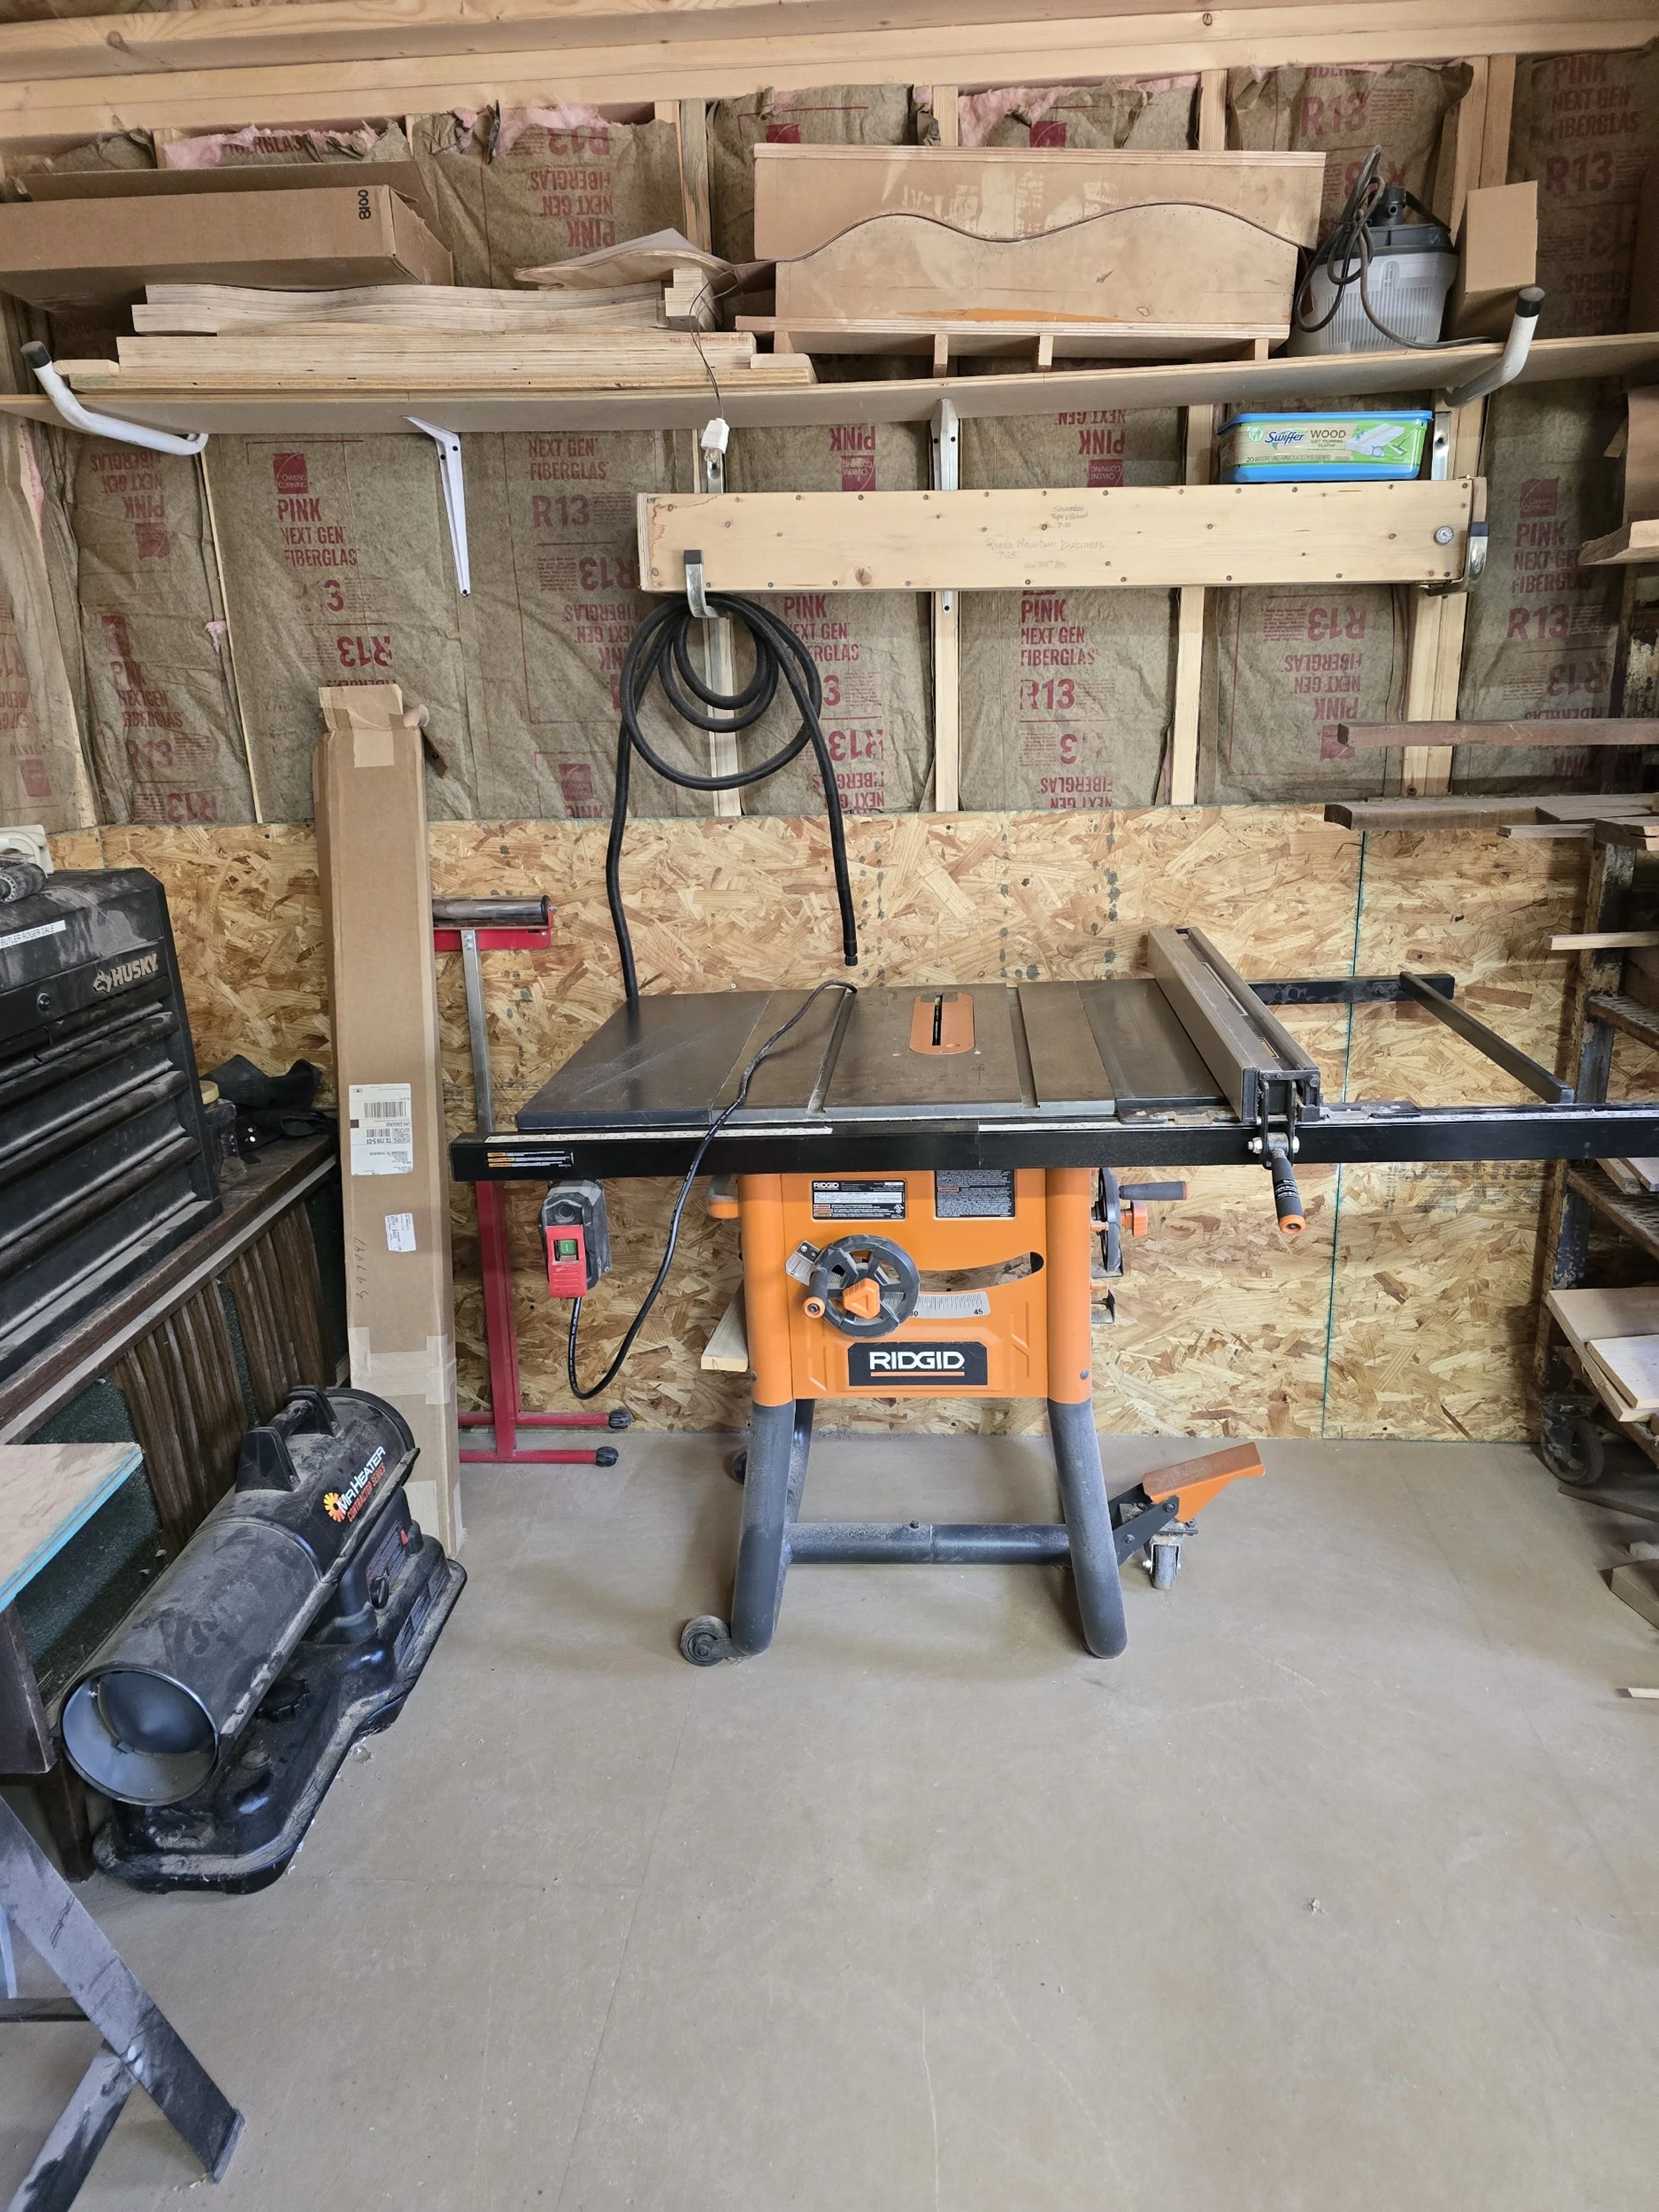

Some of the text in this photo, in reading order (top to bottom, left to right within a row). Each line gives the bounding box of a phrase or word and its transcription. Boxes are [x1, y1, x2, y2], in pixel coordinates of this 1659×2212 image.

[1300, 91, 1367, 137] R13
[530, 170, 611, 191] FIBERGLAS
[1545, 151, 1613, 192] R13
[542, 195, 613, 216] NEXT GEN
[566, 218, 616, 248] PINK
[1058, 409, 1126, 425] NEXT GEN
[830, 425, 875, 451] PINK
[1078, 429, 1125, 455] PINK
[1265, 431, 1305, 445] Swiffer
[1311, 429, 1346, 439] WOOD
[528, 439, 595, 458] NEXT GEN
[532, 461, 608, 480] FIBERGLAS
[278, 480, 307, 489] CORNING
[121, 495, 165, 519] PINK
[277, 498, 322, 522] PINK
[533, 494, 591, 528] R13
[282, 526, 344, 544] NEXT GEN
[1516, 520, 1567, 547] PINK
[285, 548, 357, 566] FIBERGLAS
[1514, 550, 1551, 571] NEXT
[579, 556, 638, 591] R13
[784, 595, 827, 619] PINK
[1021, 599, 1066, 623] PINK
[790, 623, 849, 640] EXT GEN
[1307, 605, 1367, 641] R13
[1506, 604, 1569, 639] R13
[577, 625, 604, 644] GEN
[1021, 627, 1085, 645] NEXT GEN
[336, 635, 392, 668] R13
[1021, 648, 1096, 666] FIBERGLAS
[1284, 652, 1362, 672] FIBERGLAS
[1294, 675, 1361, 694] NEXT GEN
[1547, 661, 1607, 697] R13
[1313, 697, 1359, 721] PINK
[125, 739, 173, 770] R13
[1040, 776, 1112, 794] FIBERGLAS
[167, 792, 219, 823] R13
[854, 791, 885, 808] NEXT
[1, 924, 55, 946] BUTLER ROGER DALE
[111, 953, 158, 987] HUSKY
[869, 1351, 966, 1370] RIDGID
[346, 1461, 387, 1523] CONTRACTOR SERIES
